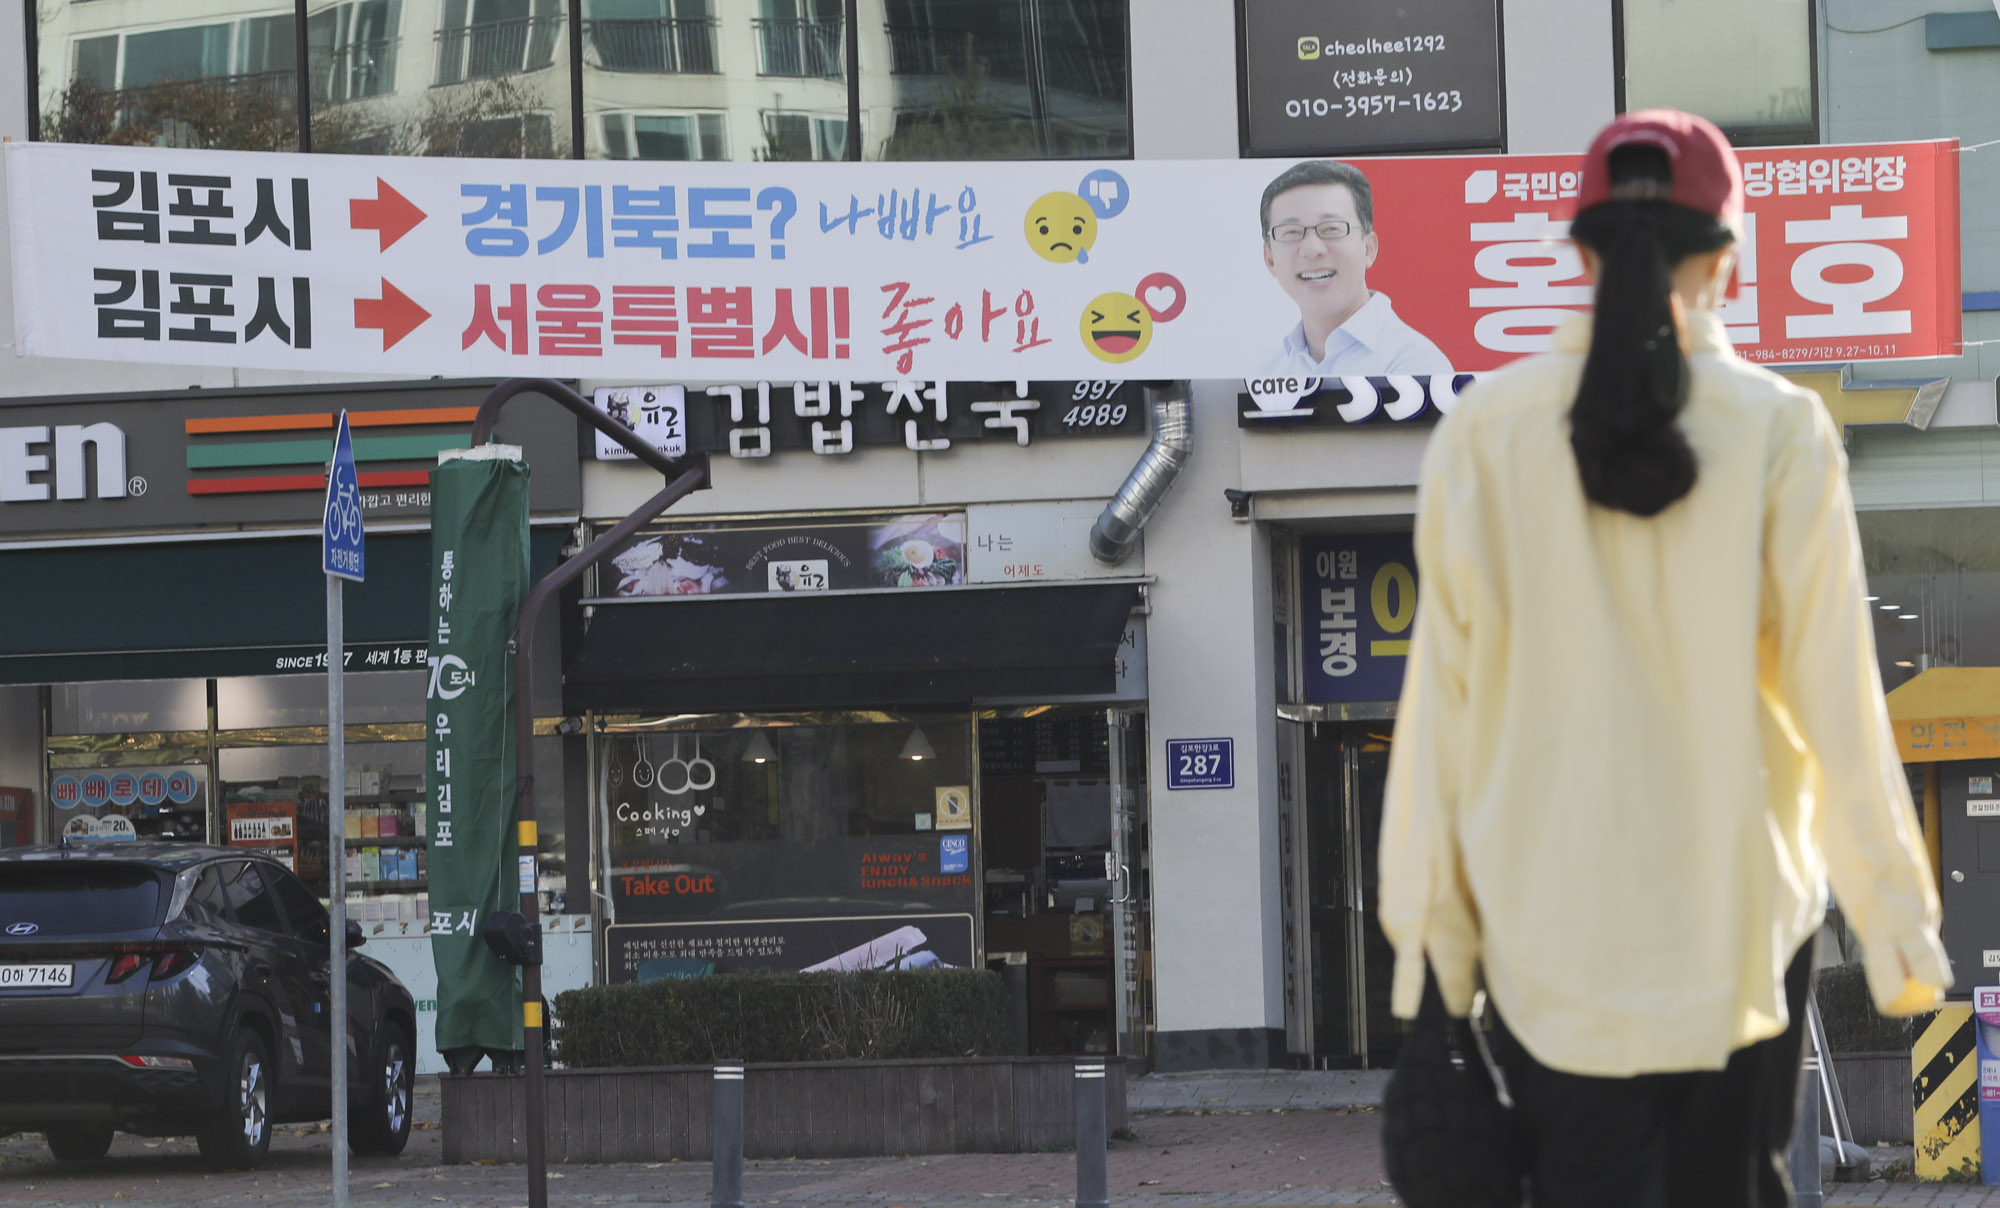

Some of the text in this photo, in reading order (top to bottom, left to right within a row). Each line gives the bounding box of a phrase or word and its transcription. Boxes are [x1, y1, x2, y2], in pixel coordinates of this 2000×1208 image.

[1324, 35, 1446, 56] cheolhee1292
[1285, 90, 1463, 118] 010-3957-1623
[1743, 155, 1906, 198] 당협위원장
[90, 168, 994, 260] 김포시 경기북도? 나빠요
[92, 267, 1052, 375] 김포시 서울특별시! 좋아요
[1836, 344, 1897, 357] 9.27~10.11
[1071, 380, 1123, 401] 997
[705, 380, 1040, 458] 김밥천국
[1062, 404, 1128, 427] 4989
[330, 546, 360, 573] 자전거횡단
[745, 535, 851, 571] BEST FOOD BEST DELICIOUS
[1316, 550, 1358, 580] 이원
[437, 550, 454, 645] 통하는
[275, 656, 313, 669] SINCE
[365, 650, 390, 665] 세계
[393, 647, 412, 664] 1등
[1180, 754, 1221, 775] 287
[56, 776, 190, 801] 빼빼로데이
[434, 713, 453, 847] 우리김포
[616, 802, 692, 827] Cooking
[861, 865, 909, 877] ENJOY
[621, 873, 715, 896] Take Out
[623, 939, 657, 950] 매일매일
[660, 938, 685, 949] 신선한
[743, 935, 786, 947] 위생관리로
[28, 967, 67, 983] 7146
